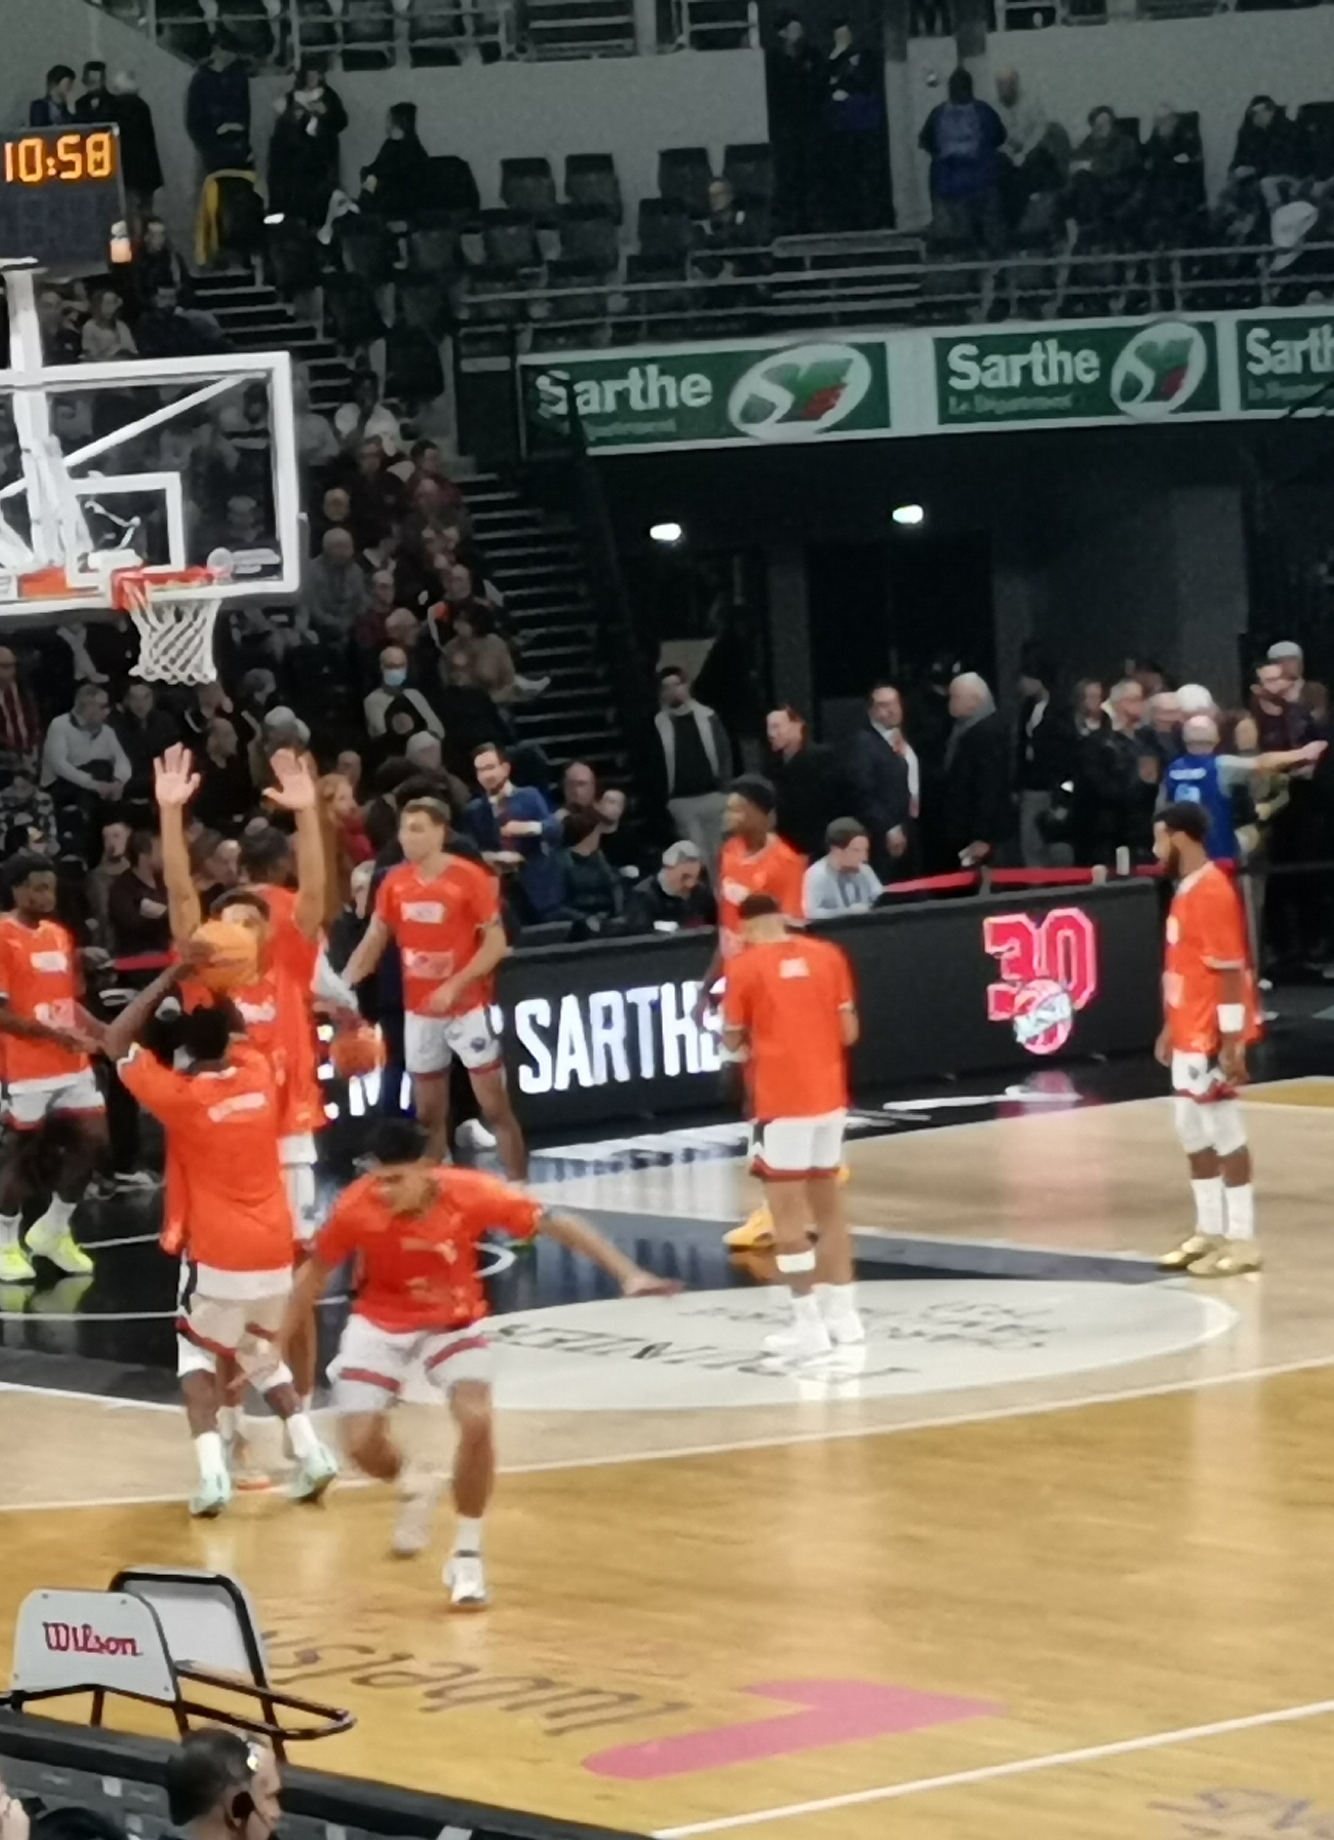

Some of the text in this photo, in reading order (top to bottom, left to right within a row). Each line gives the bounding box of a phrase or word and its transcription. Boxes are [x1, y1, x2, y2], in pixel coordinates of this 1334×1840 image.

[535, 364, 713, 419] Sarthe
[947, 338, 1101, 391] Sarthe
[983, 907, 1098, 1022] 30
[42, 1621, 144, 1656] Wilson
